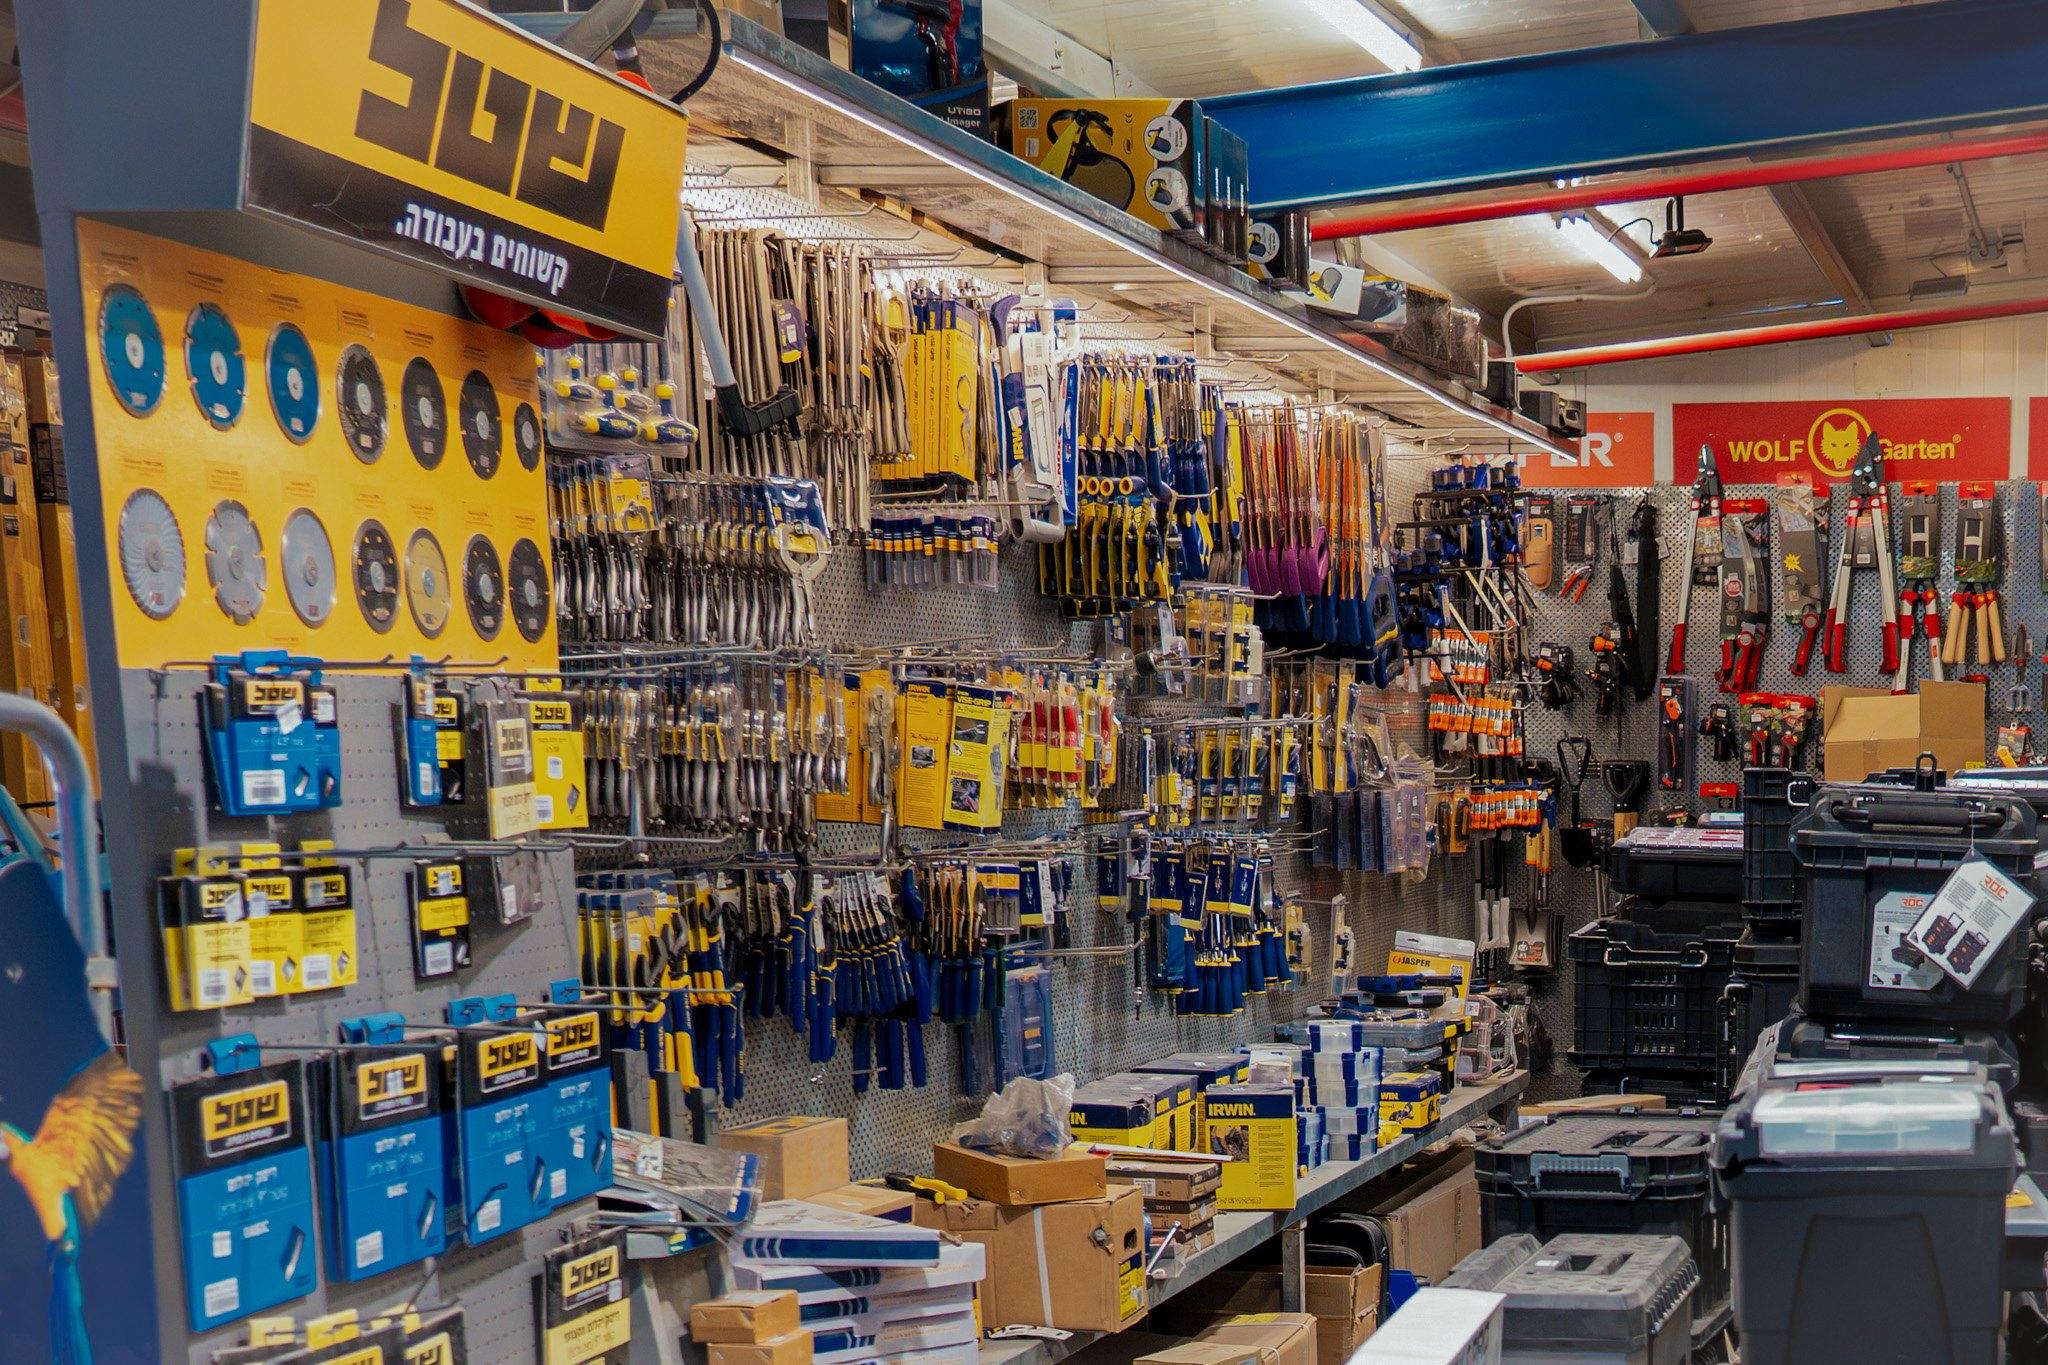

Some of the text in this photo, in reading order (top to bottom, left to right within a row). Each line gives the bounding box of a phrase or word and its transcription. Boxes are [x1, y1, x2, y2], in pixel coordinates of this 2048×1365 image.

[354, 0, 626, 233] שטל
[490, 234, 569, 296] קשוחים
[1011, 422, 1024, 460] IRW
[1728, 440, 1804, 462] WOLF
[1983, 874, 2009, 900] ROC
[1401, 956, 1431, 968] JASPER
[487, 1039, 532, 1071] שטל
[214, 1092, 281, 1132] שטל
[570, 1255, 613, 1290] שטל
